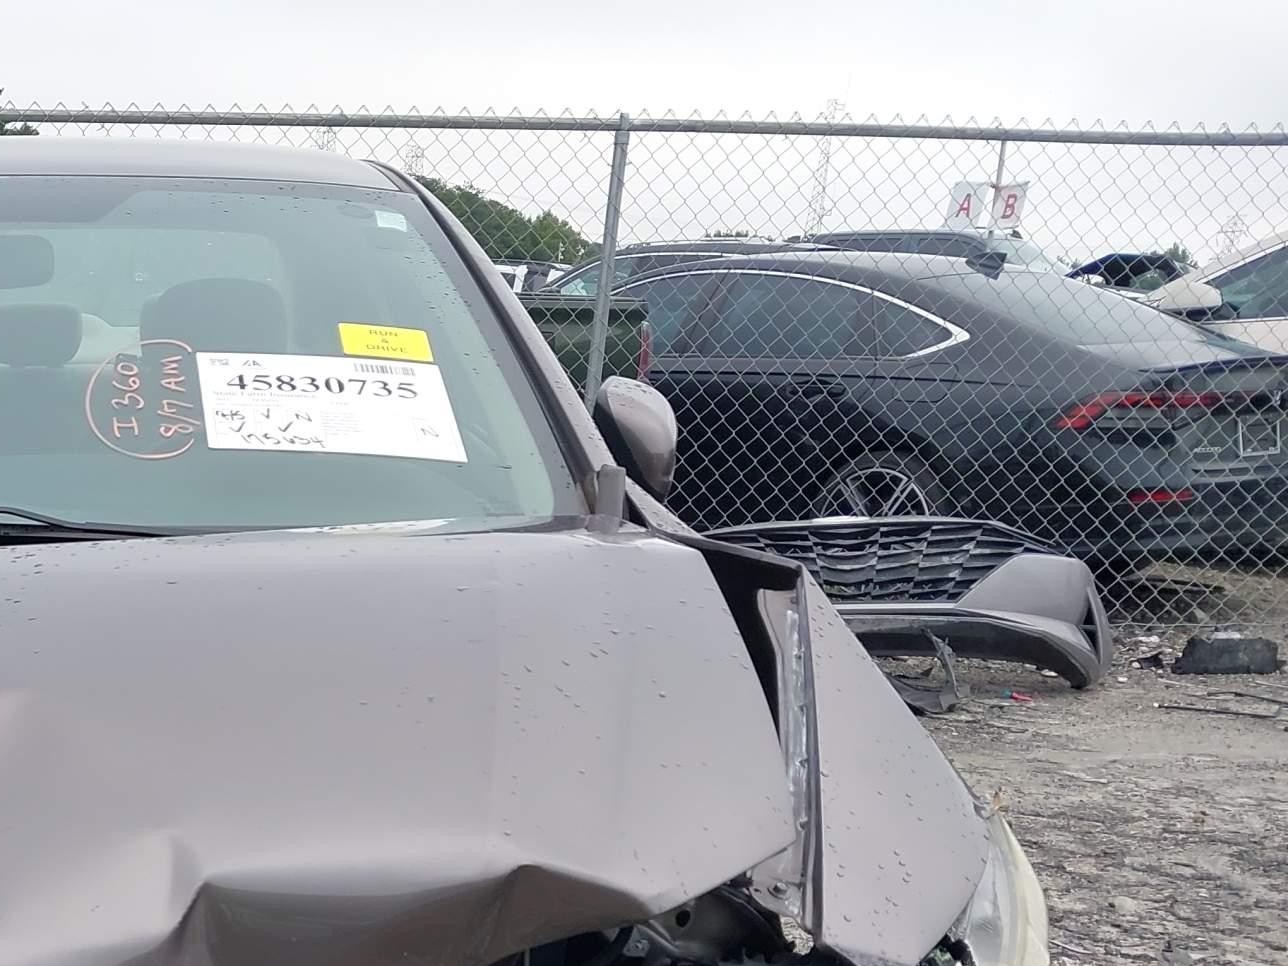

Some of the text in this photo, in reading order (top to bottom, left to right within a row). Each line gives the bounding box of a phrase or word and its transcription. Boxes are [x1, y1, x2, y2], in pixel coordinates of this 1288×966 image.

[955, 193, 971, 218] A
[1001, 193, 1017, 219] B
[369, 329, 398, 337] RUN
[366, 344, 409, 353] DRIVE
[111, 361, 145, 409] 360
[160, 355, 187, 393] AM
[226, 373, 418, 399] 45830735
